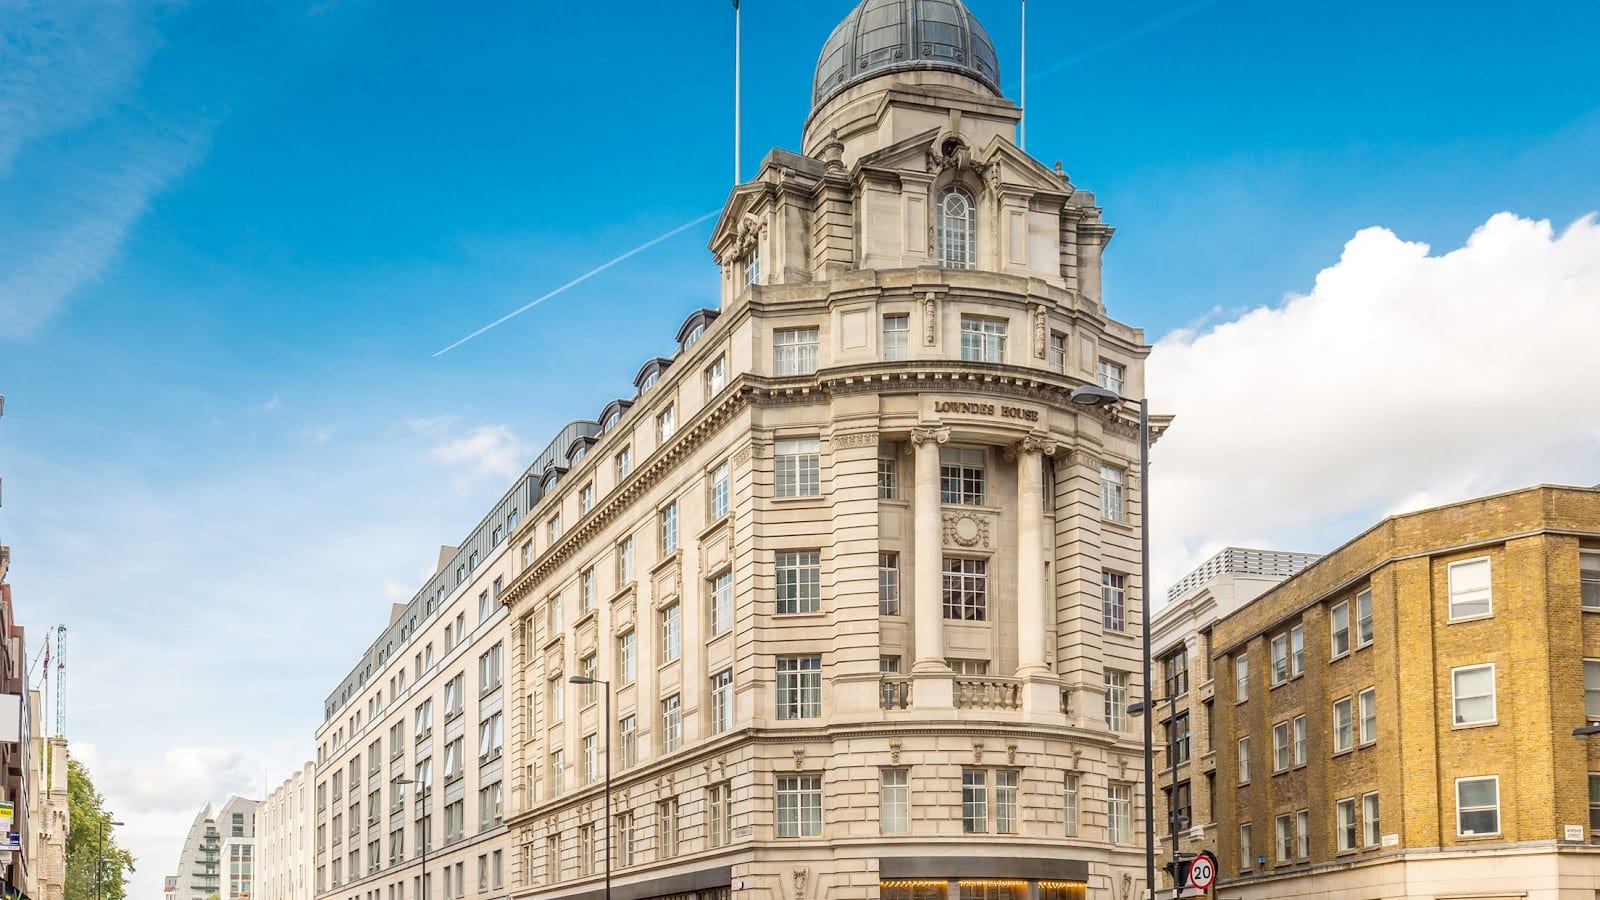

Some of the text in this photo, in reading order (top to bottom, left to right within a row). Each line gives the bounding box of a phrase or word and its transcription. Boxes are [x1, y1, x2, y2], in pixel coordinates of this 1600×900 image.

[935, 401, 1039, 421] LOWNDES HOUSE
[1194, 865, 1211, 880] 20
